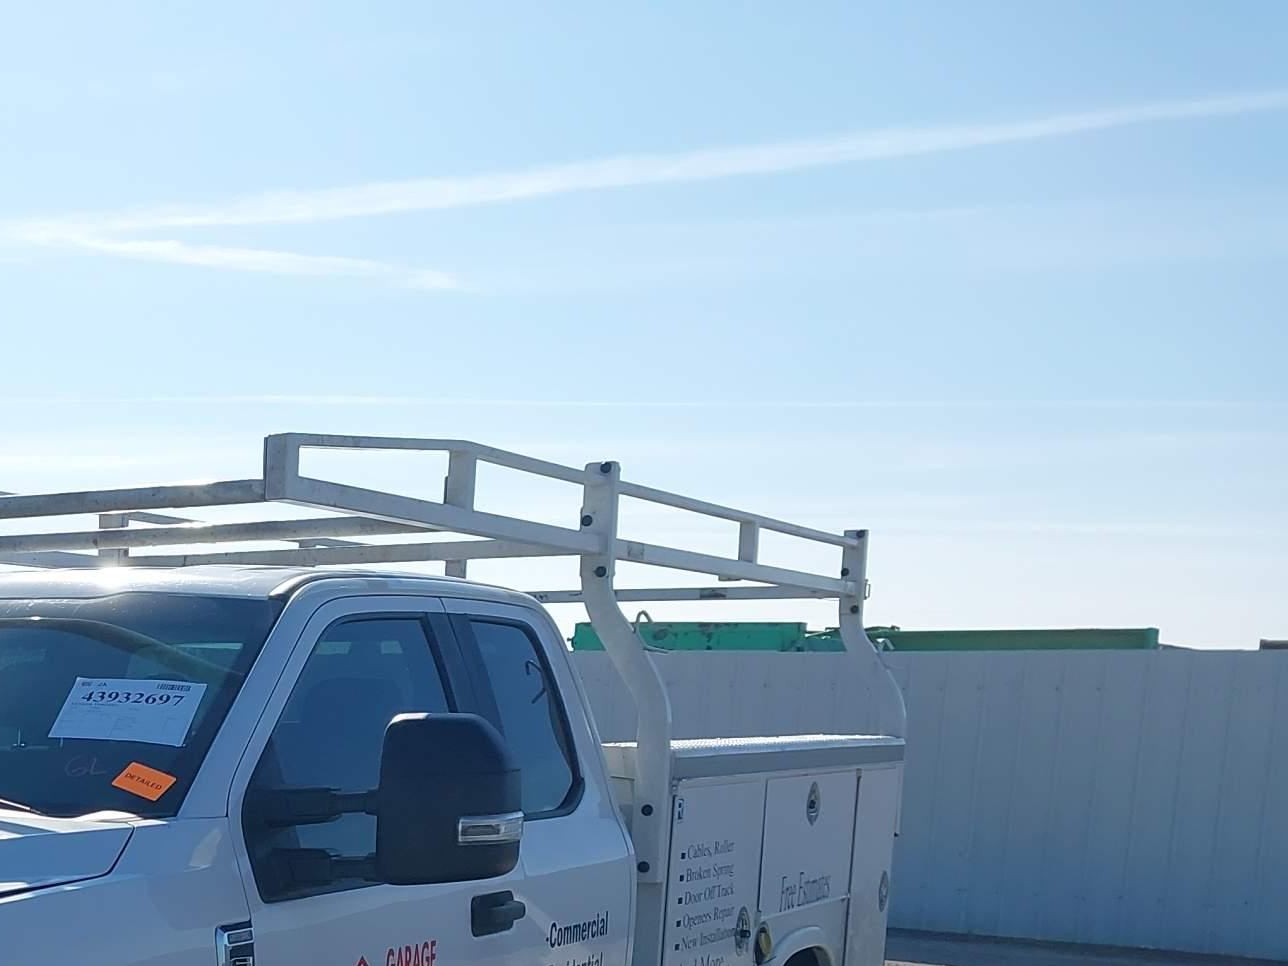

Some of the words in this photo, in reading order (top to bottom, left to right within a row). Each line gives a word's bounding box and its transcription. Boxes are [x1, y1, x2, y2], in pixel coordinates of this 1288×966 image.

[81, 690, 185, 707] 43932697
[124, 771, 162, 791] DETAILED
[684, 890, 703, 906] Door
[778, 875, 797, 913] Free
[682, 935, 697, 951] New
